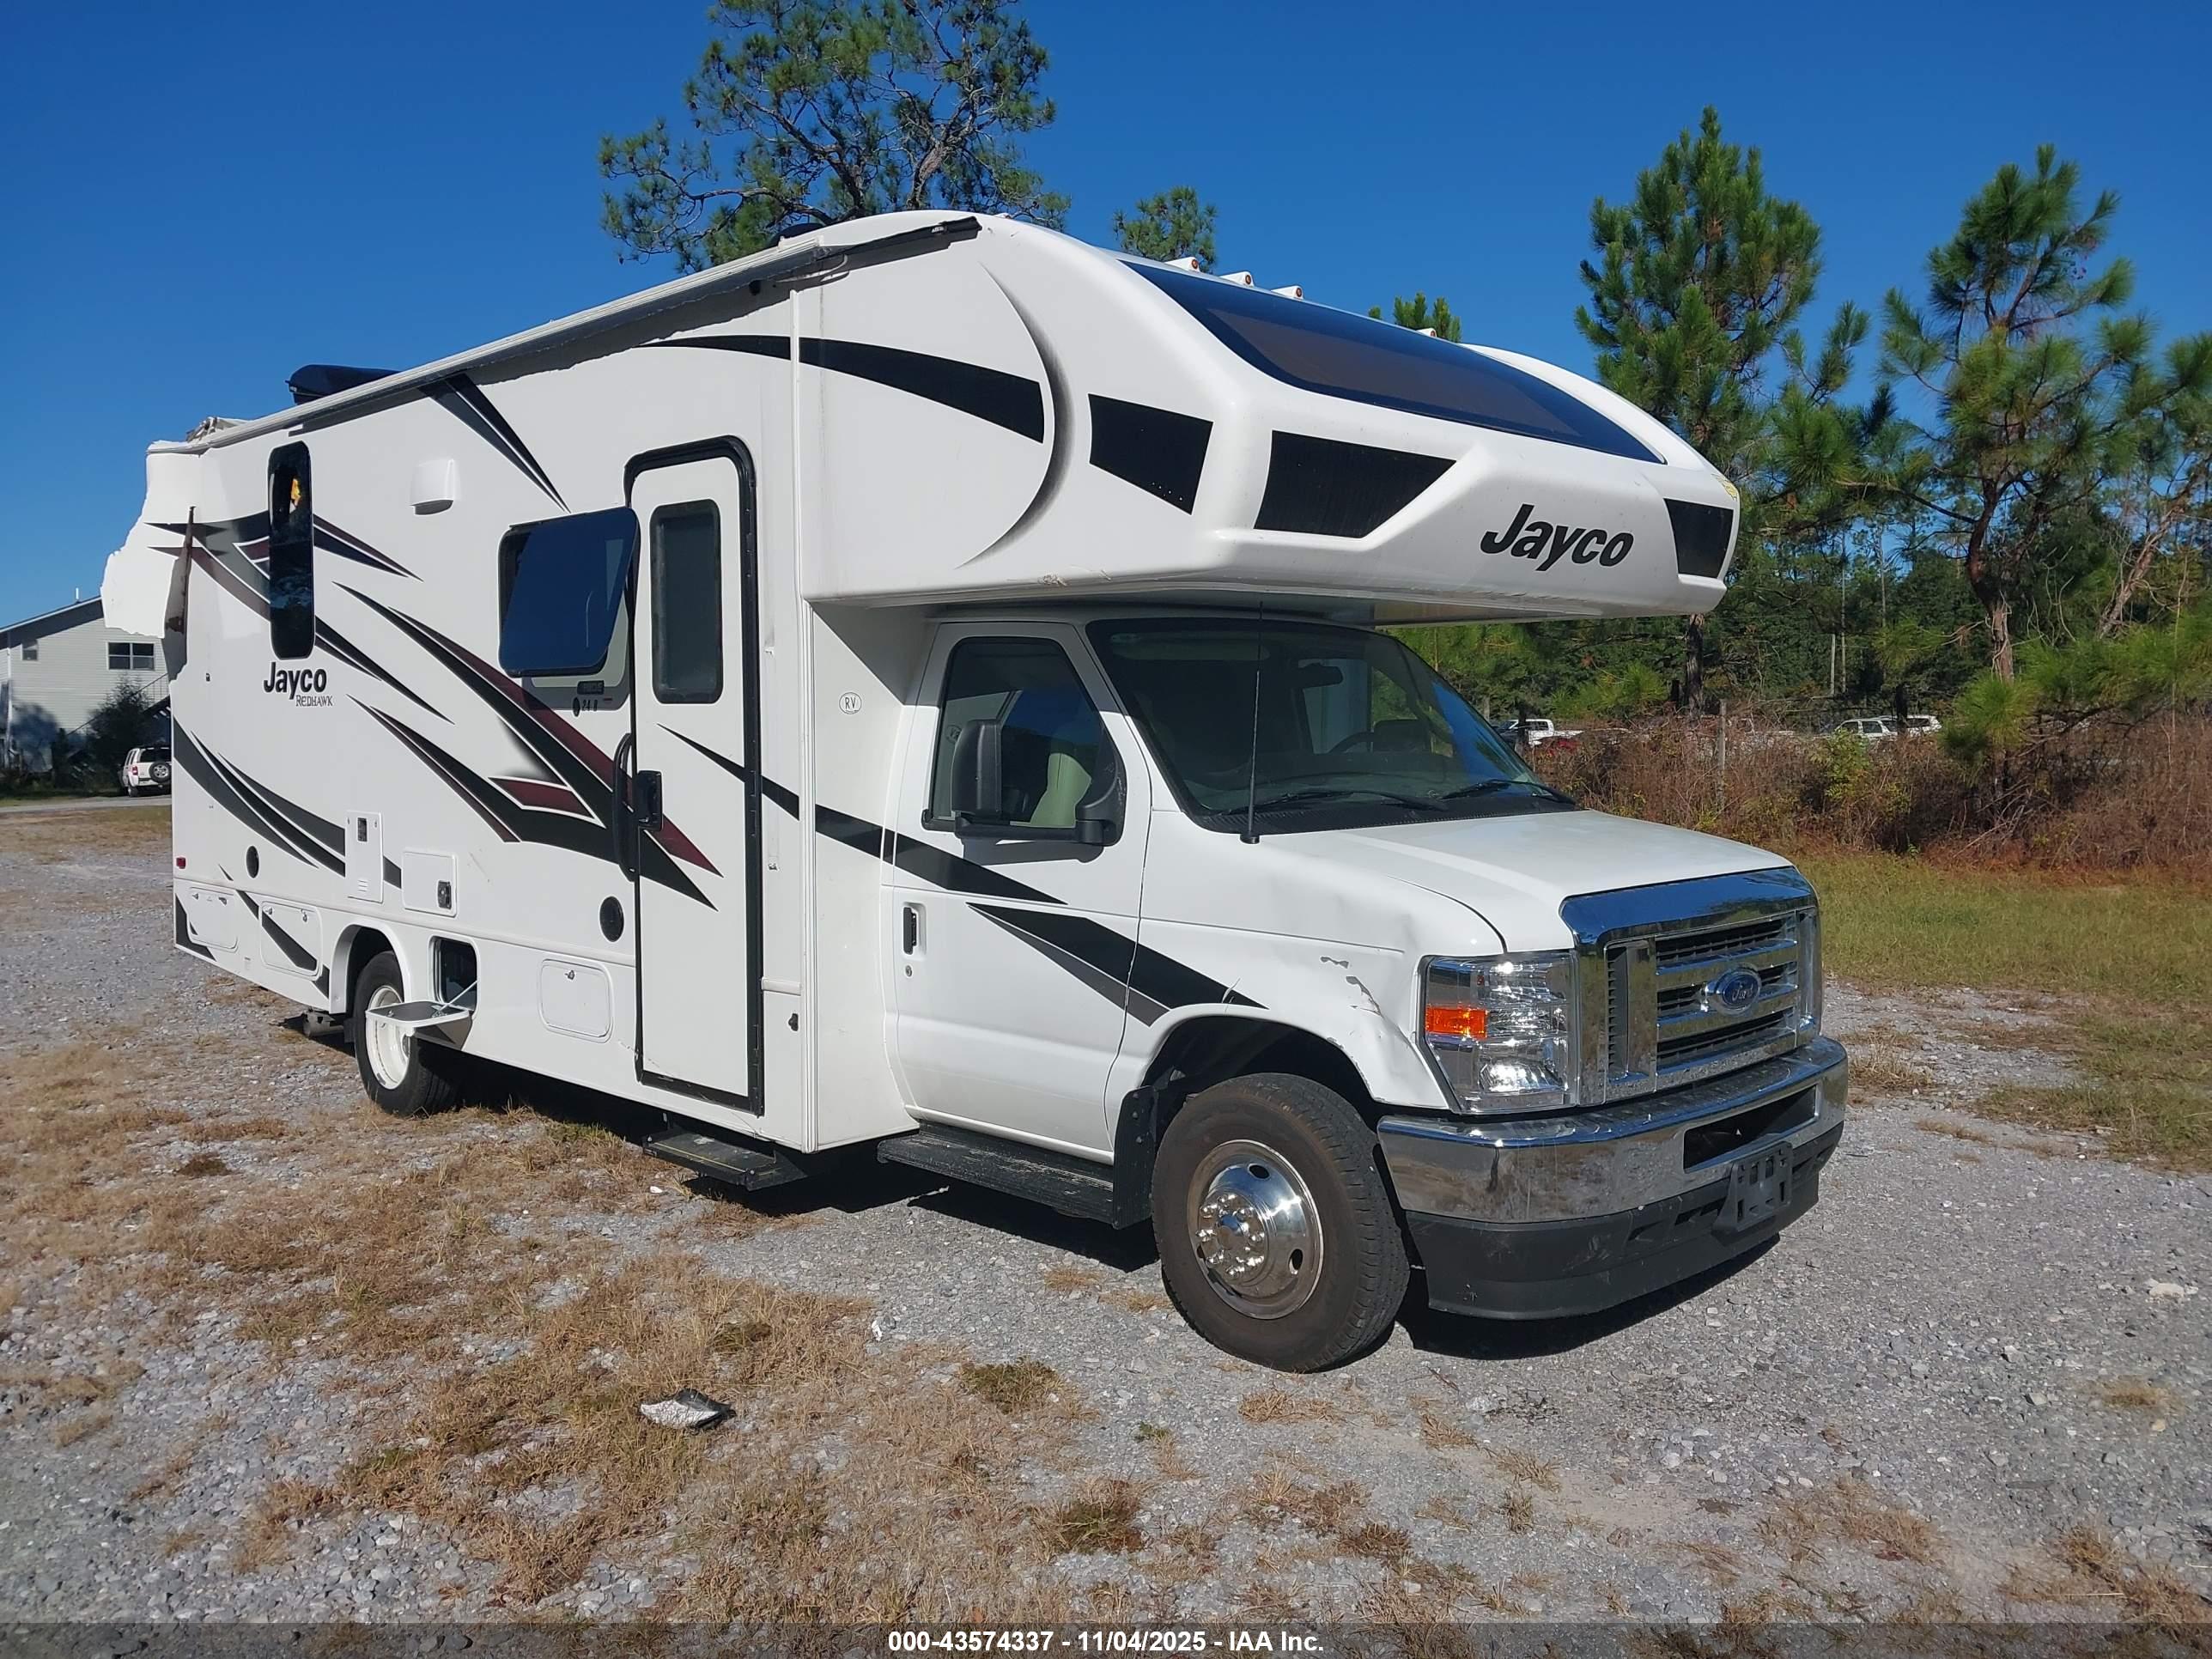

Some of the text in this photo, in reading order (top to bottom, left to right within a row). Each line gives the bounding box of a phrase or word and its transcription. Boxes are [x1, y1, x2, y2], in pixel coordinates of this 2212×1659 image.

[1480, 503, 1634, 571] Jayco
[263, 661, 327, 700] Jayco
[295, 695, 333, 708] REDHAWK
[844, 696, 857, 710] RV
